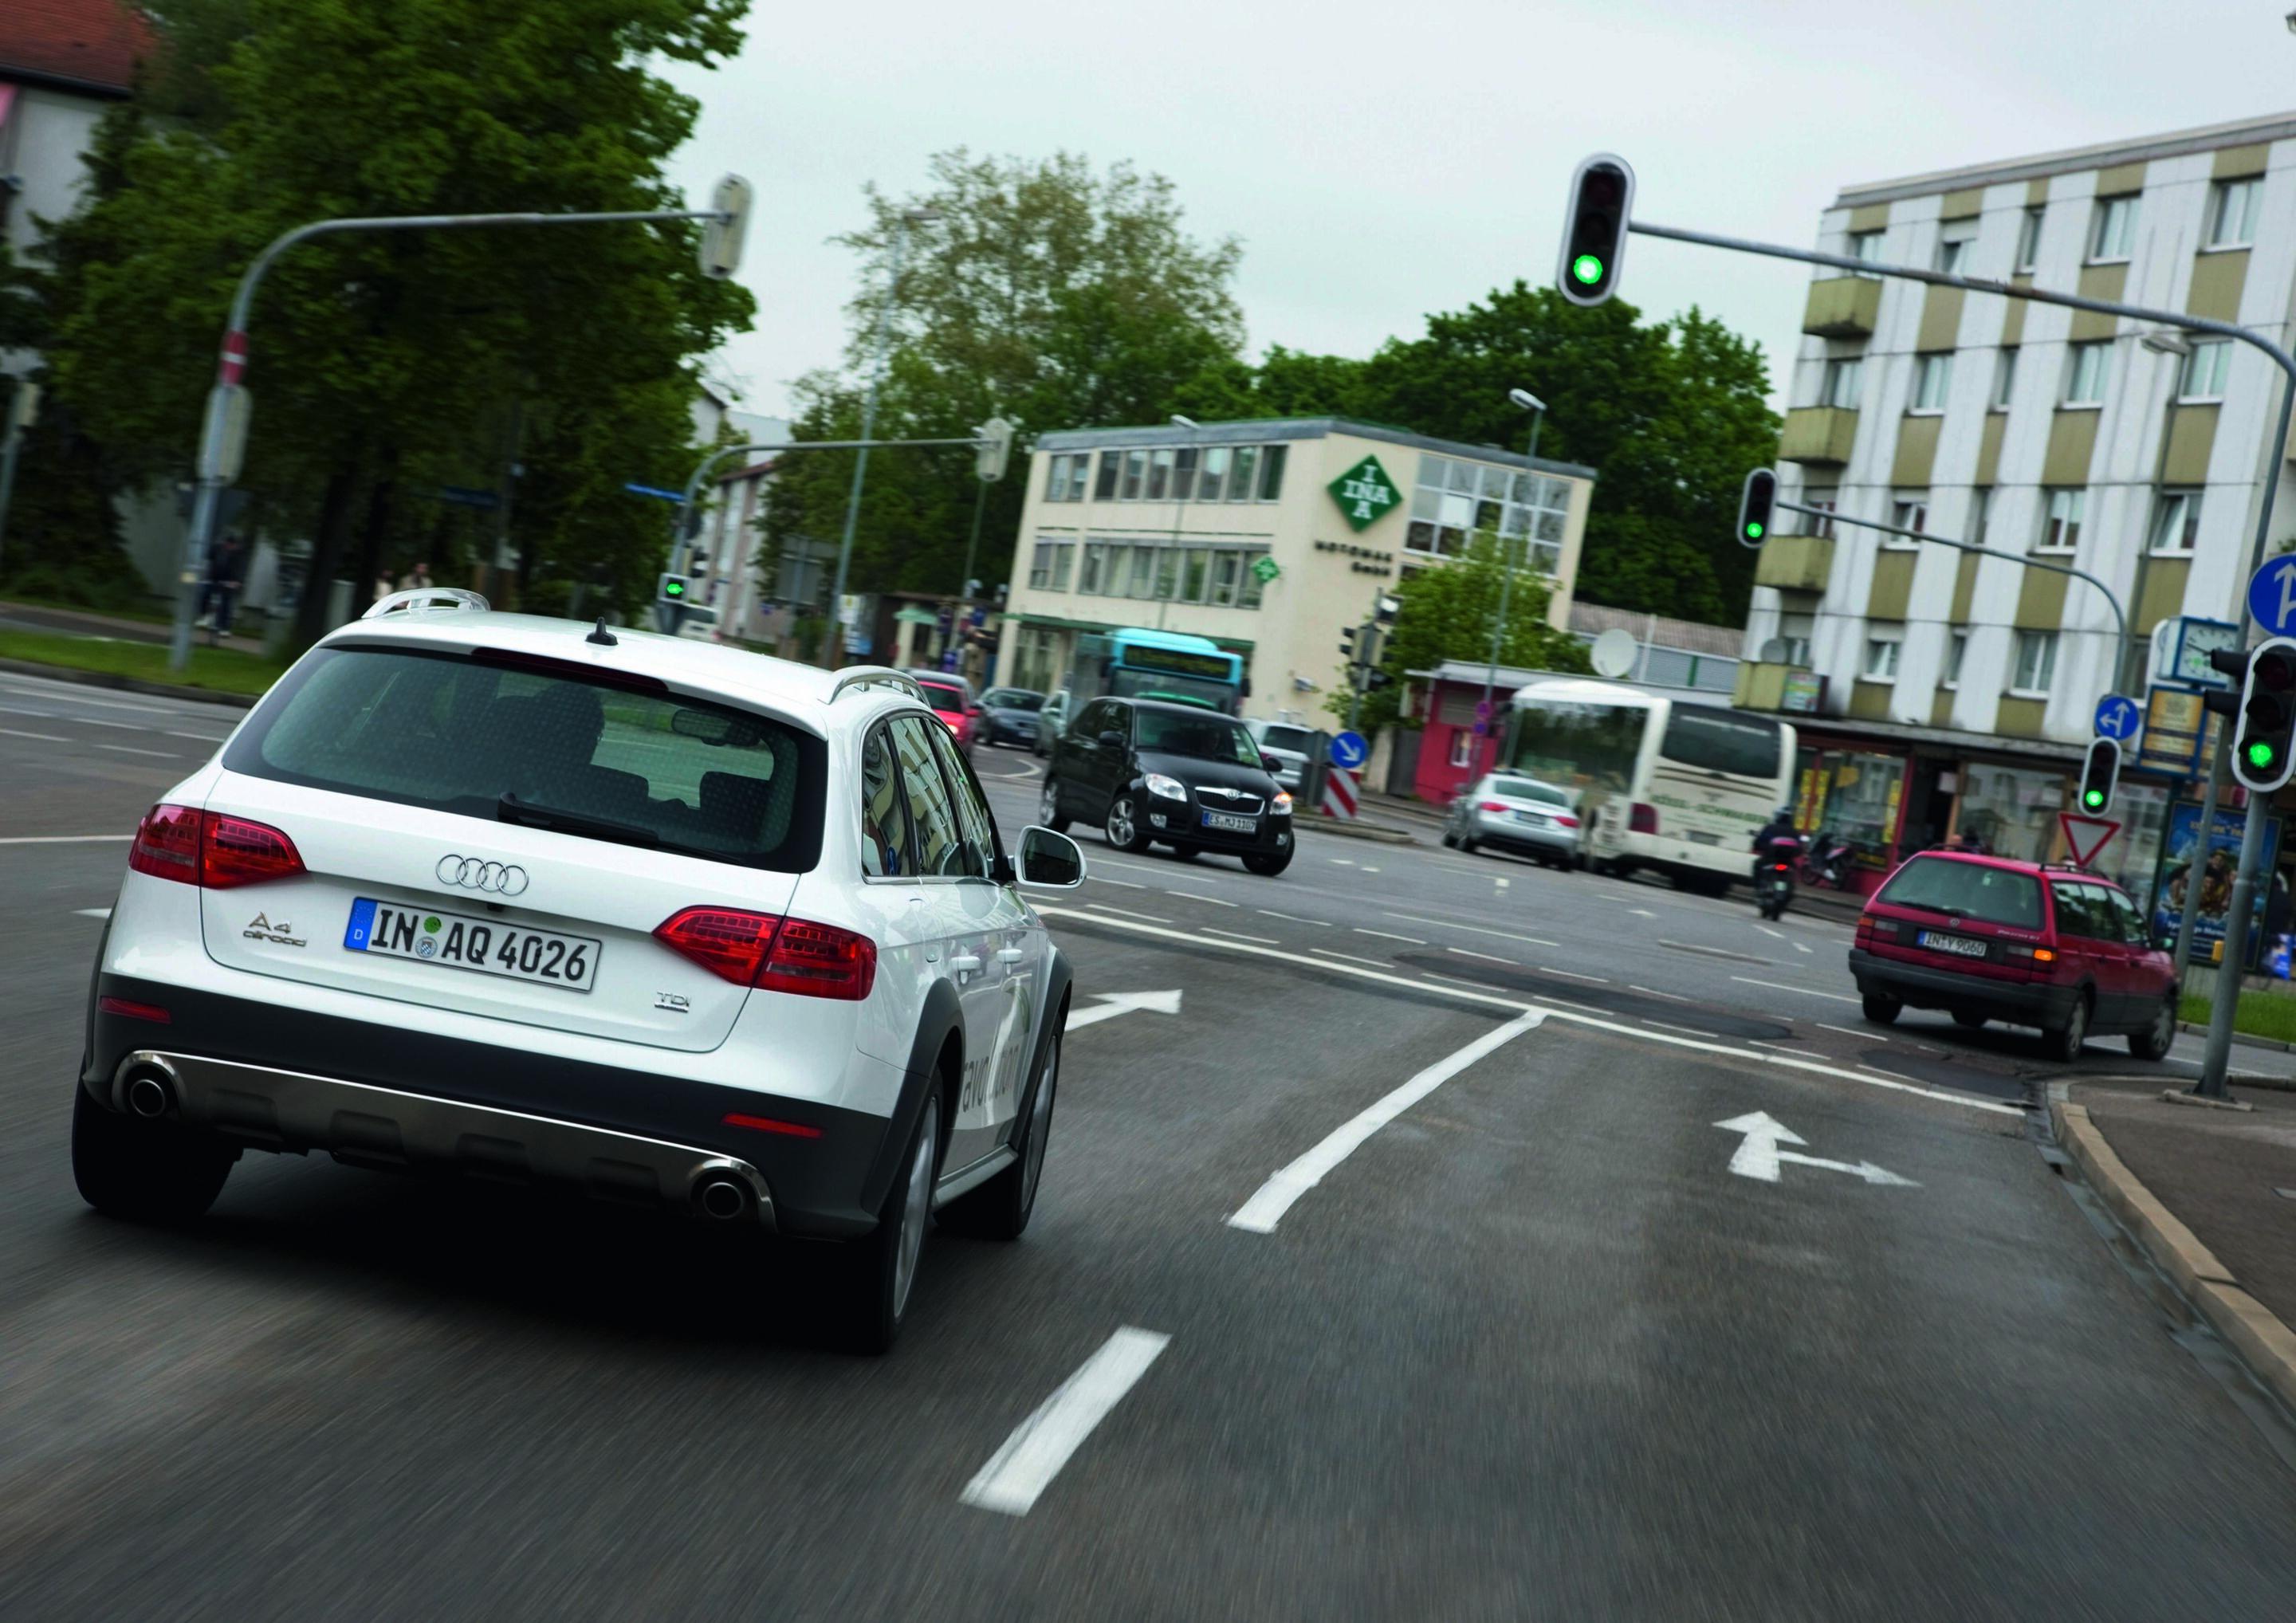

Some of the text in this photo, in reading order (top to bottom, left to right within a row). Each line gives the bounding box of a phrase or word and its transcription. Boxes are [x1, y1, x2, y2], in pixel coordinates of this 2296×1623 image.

[1342, 479, 1391, 505] INA
[248, 910, 292, 934] A4
[242, 929, 307, 947] allroad
[353, 929, 364, 941] D
[371, 909, 588, 981] IN AQ 4026
[656, 990, 691, 1007] TDI
